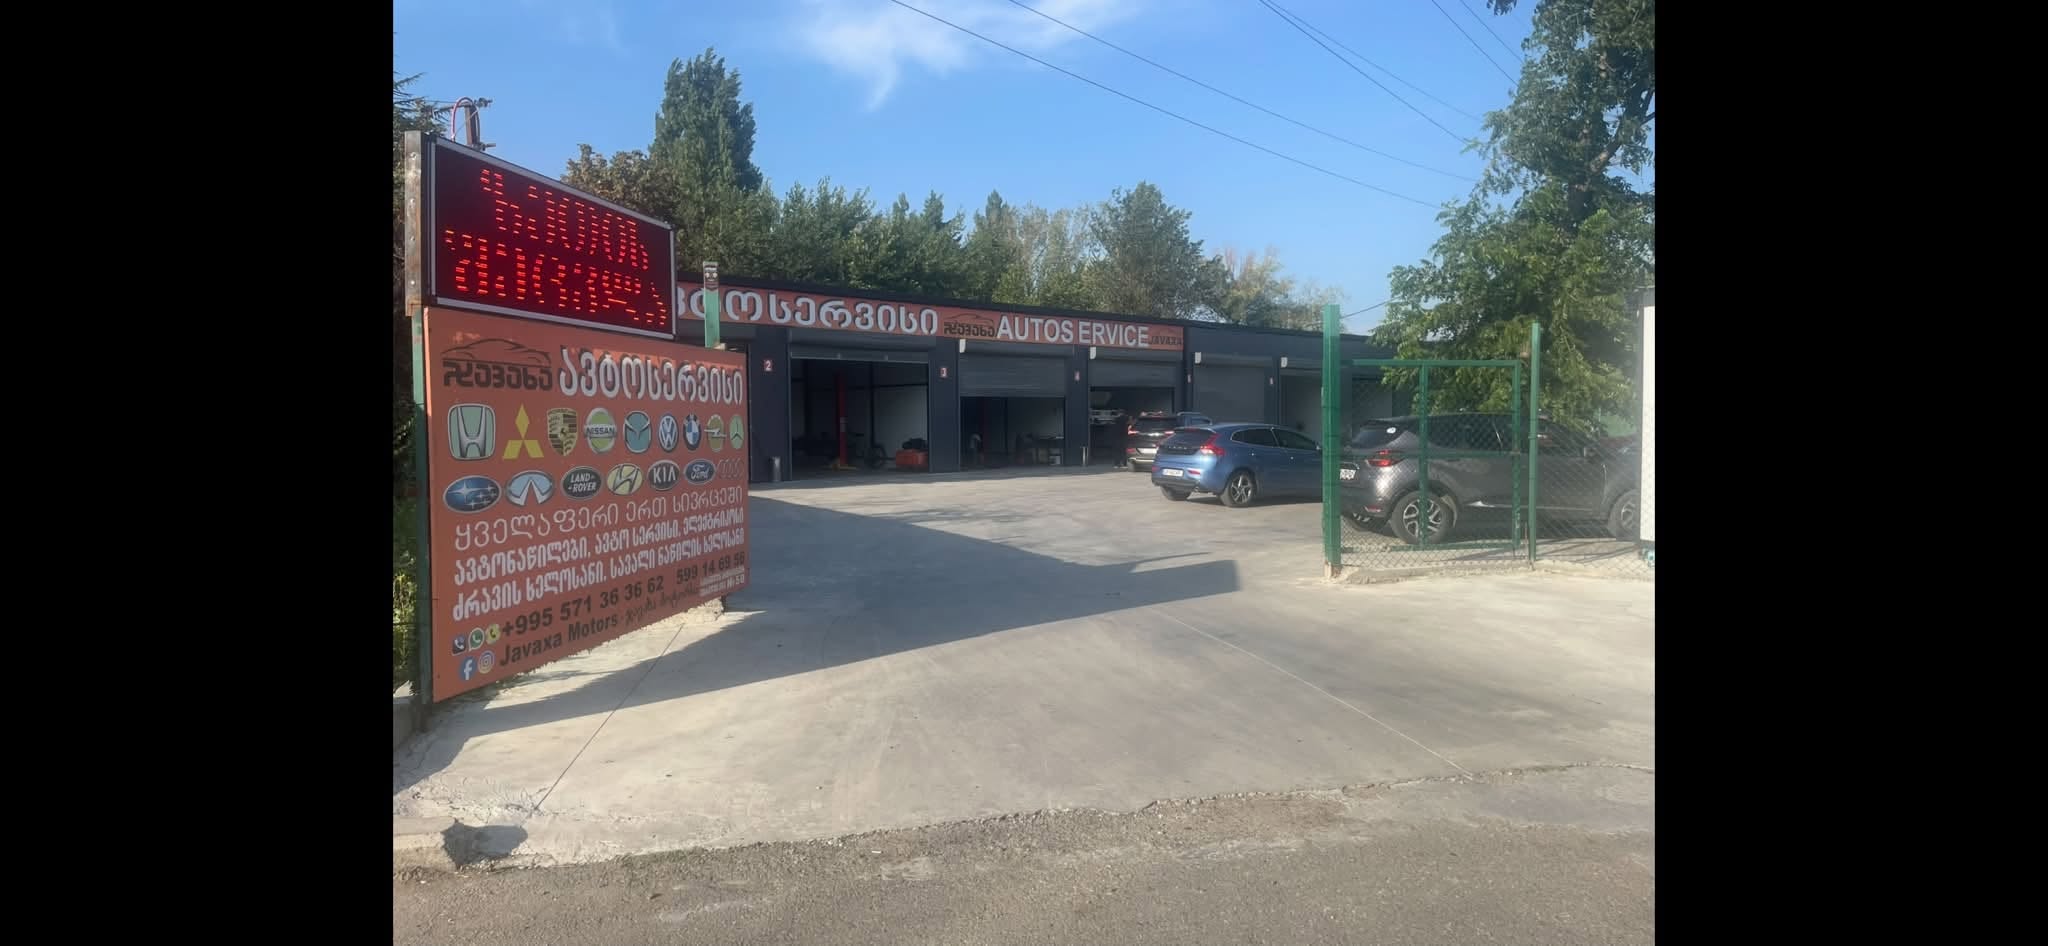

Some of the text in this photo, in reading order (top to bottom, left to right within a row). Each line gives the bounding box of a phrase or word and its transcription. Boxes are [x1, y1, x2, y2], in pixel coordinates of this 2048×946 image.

[559, 347, 743, 406] ავტოსერვისი
[586, 427, 615, 435] NISSAN
[570, 473, 590, 483] LAND
[653, 467, 676, 482] KIA
[690, 464, 709, 480] Ford
[572, 482, 597, 493] ROVER
[455, 486, 743, 550] ყველაფერი ერთ სივრცეში
[595, 528, 629, 554] ავტო
[453, 580, 522, 621] ძრავის
[610, 548, 655, 578] სავალი
[658, 536, 702, 566] ნაწილის
[502, 607, 553, 637] +995
[560, 595, 592, 621] 571
[600, 587, 618, 609] 36
[624, 582, 642, 601] 36
[647, 575, 664, 593] 62
[677, 565, 698, 585] 599
[703, 560, 715, 577] 14
[719, 555, 730, 571] 69
[500, 613, 619, 667] Javaxa Motors
